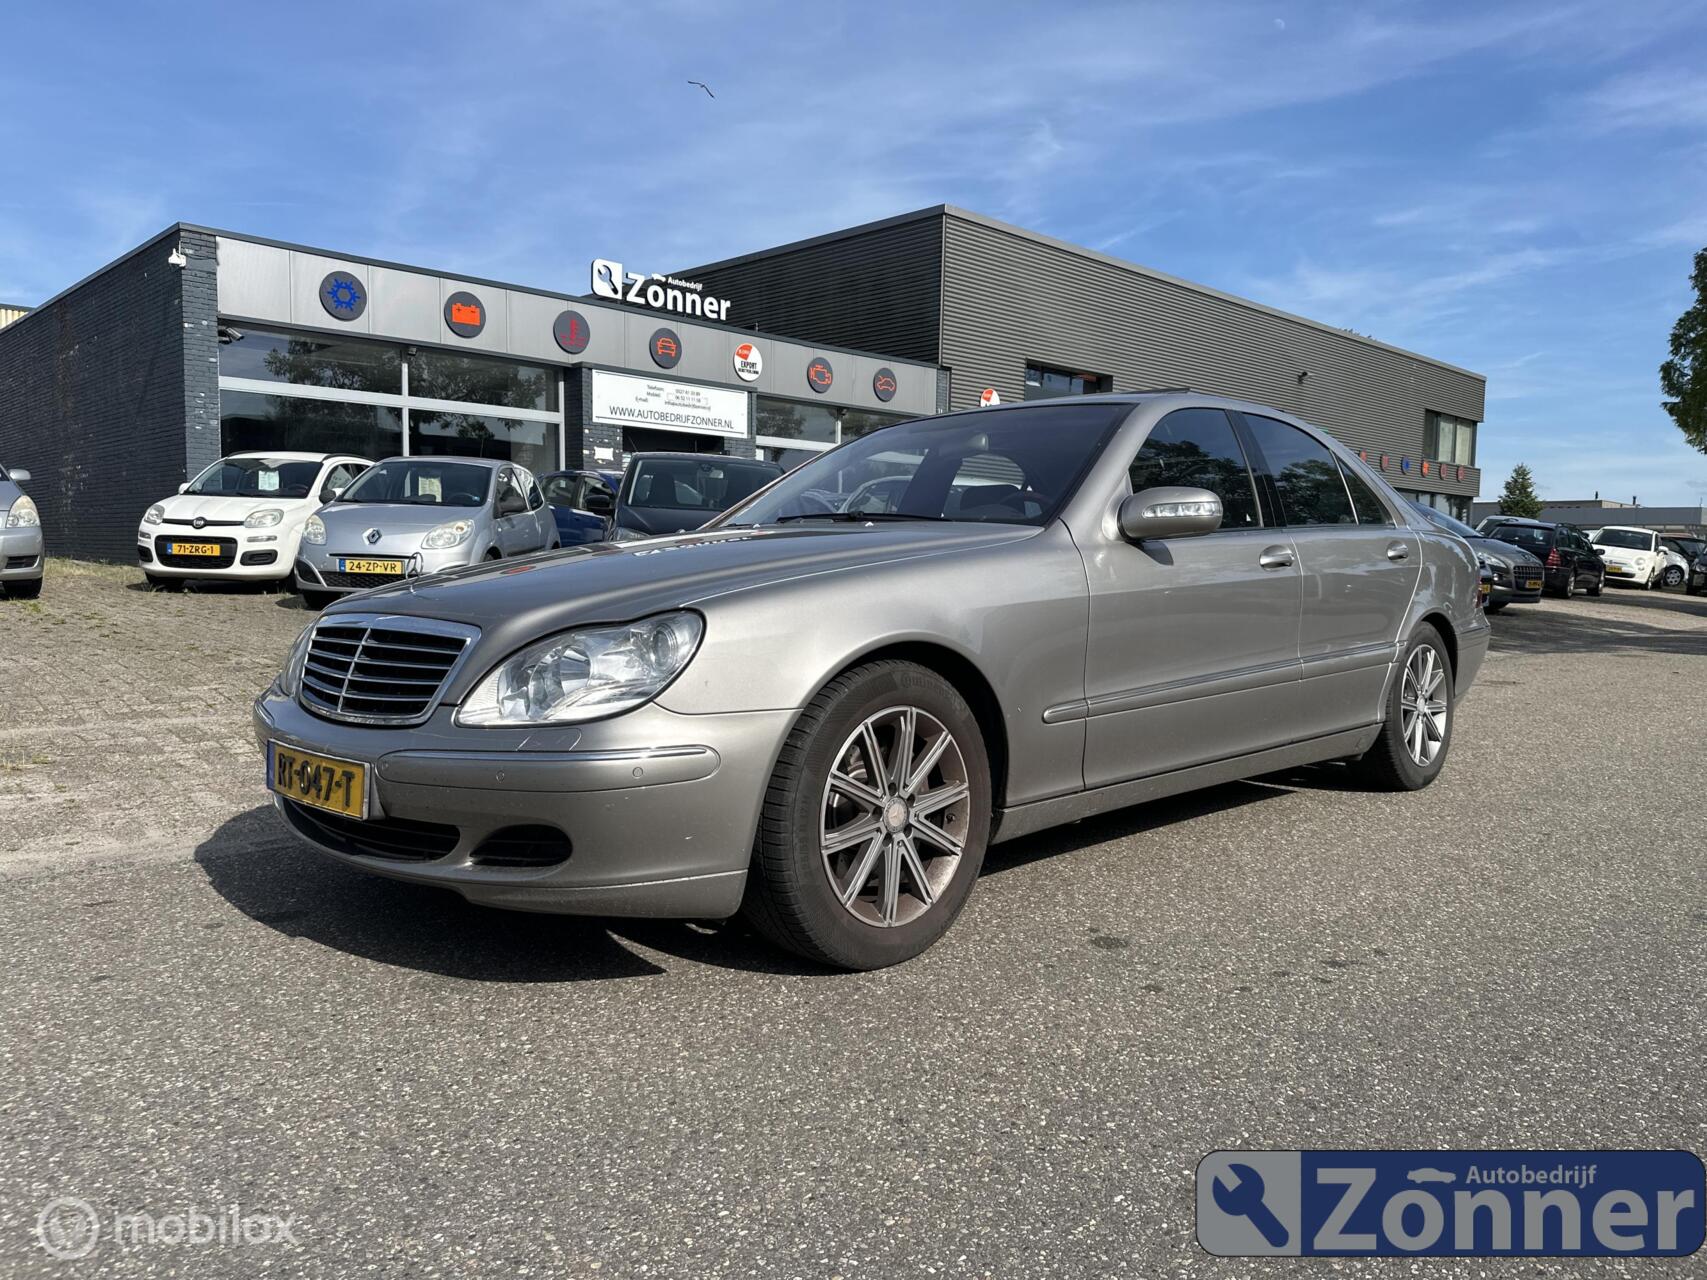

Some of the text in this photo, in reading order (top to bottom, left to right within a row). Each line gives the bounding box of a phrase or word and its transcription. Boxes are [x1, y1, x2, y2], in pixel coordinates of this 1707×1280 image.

[667, 276, 703, 292] Autobedrijf
[626, 272, 731, 321] Zonner
[609, 405, 734, 429] WWW.AUTOBEDRIJFZONNER.NL
[177, 544, 214, 555] 71-ZRG-1
[349, 558, 398, 573] 24-ZP-VR
[278, 752, 355, 809] RT-047-T
